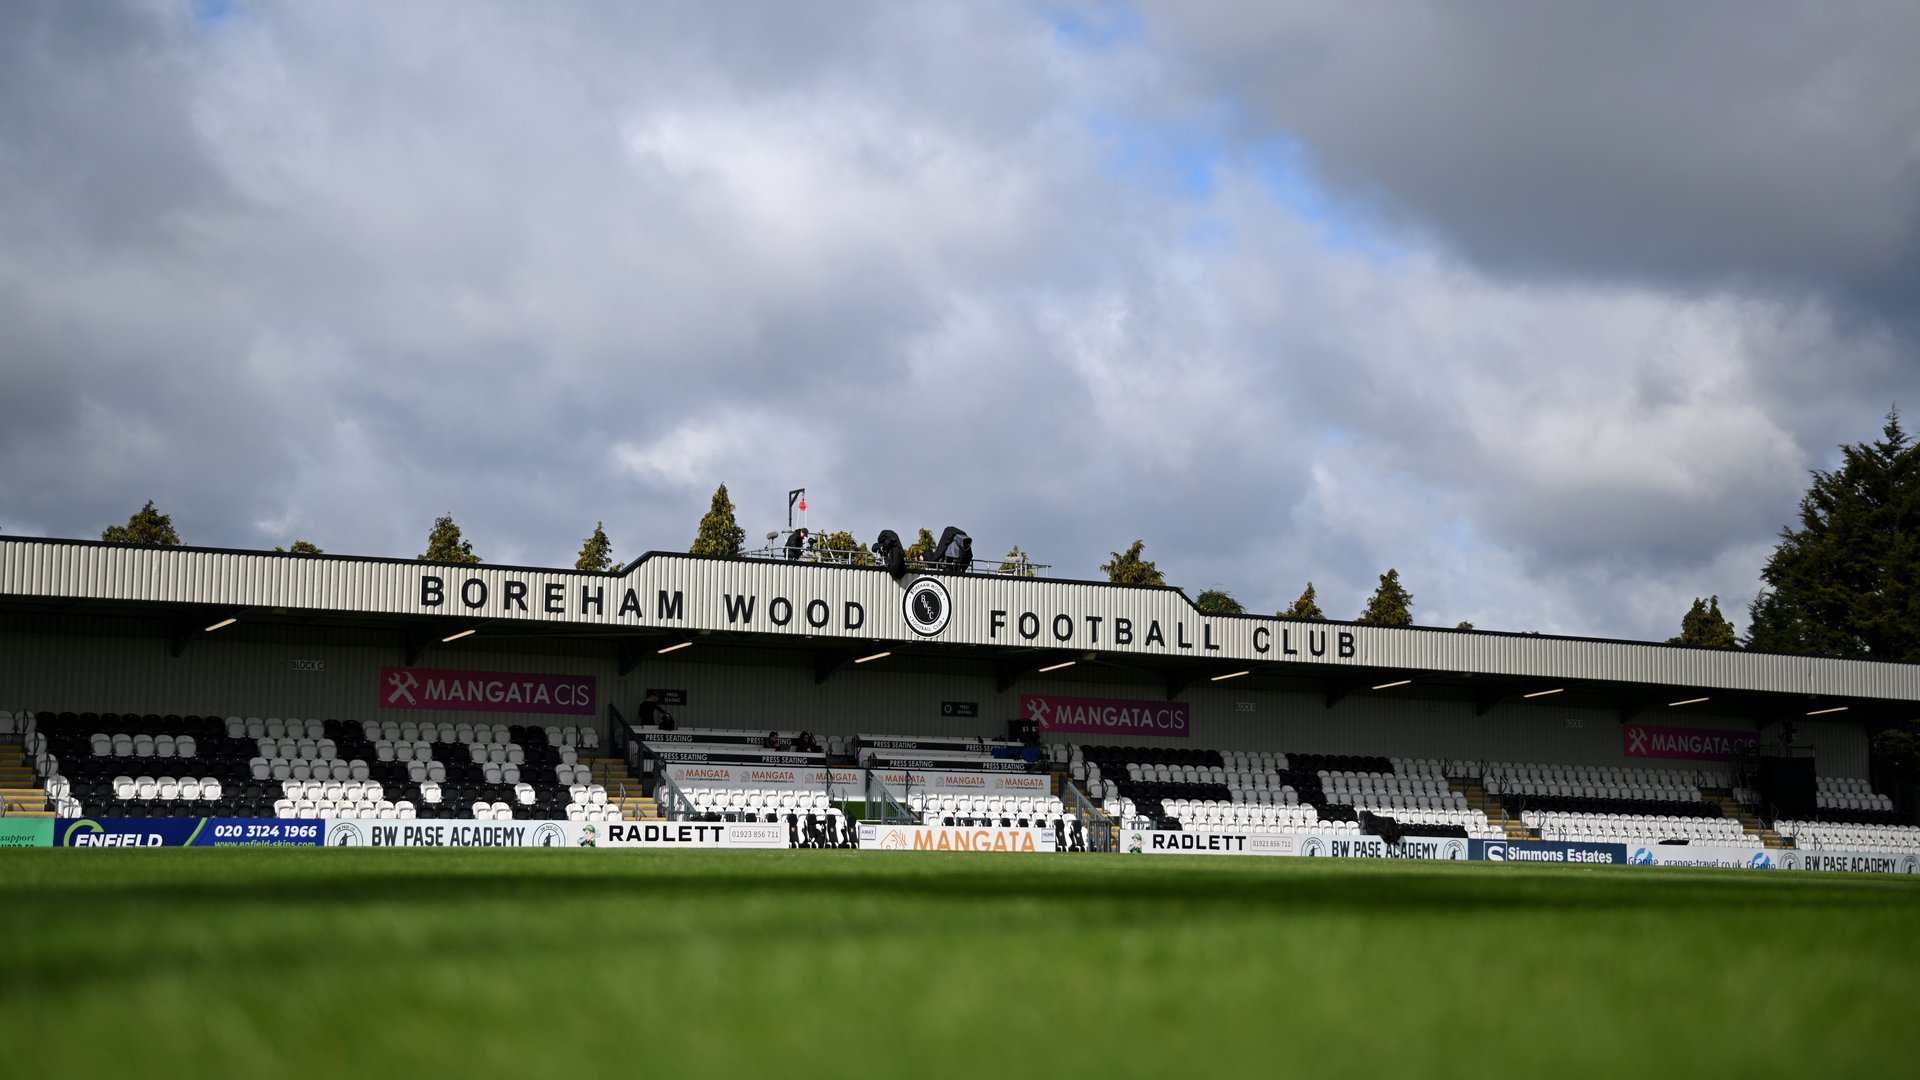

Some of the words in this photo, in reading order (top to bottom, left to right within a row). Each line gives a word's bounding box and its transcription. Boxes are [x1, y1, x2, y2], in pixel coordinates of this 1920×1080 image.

[421, 575, 684, 621] BOREHAM
[724, 594, 864, 630] WOOD
[990, 610, 1220, 651] FOOTBALL
[1252, 626, 1355, 659] CLUB
[424, 678, 550, 704] MANGATA
[554, 684, 590, 706] CIS
[1054, 704, 1154, 728] MANGATA
[1157, 709, 1185, 731] CIS
[645, 734, 664, 742] PRESS
[665, 735, 693, 743] SEATING
[746, 737, 764, 745] PRESS
[892, 741, 917, 749] SEATING
[1651, 733, 1731, 755] MANGATA
[680, 753, 708, 761] SEATING
[781, 756, 808, 764] SEATING
[908, 760, 934, 768] SEATING
[1000, 763, 1025, 771] SEATING
[686, 769, 730, 778] MANGATA
[752, 771, 795, 780] MANGATA
[815, 772, 858, 782] MANGATA
[884, 774, 926, 783] MANGATA
[945, 776, 986, 785] MANGATA
[1005, 778, 1044, 787] MANGATA
[214, 825, 243, 838] 020
[246, 825, 280, 838] 3124
[284, 826, 318, 839] 1966
[608, 825, 724, 842] RADLETT
[731, 830, 752, 839] 01923
[753, 830, 766, 839] 856
[767, 831, 779, 839] 711
[372, 826, 398, 847] BW
[404, 826, 444, 847] PASE
[451, 826, 525, 848] ACADEMY
[913, 829, 1036, 853] MANGATA
[1152, 833, 1247, 851] RADLETT
[1252, 840, 1269, 848] 01923
[1269, 840, 1280, 848] 856
[1332, 841, 1350, 858] BW
[1354, 841, 1382, 859] PASE
[1385, 842, 1438, 860] ACADEMY
[1508, 846, 1564, 861] Simmons
[1567, 848, 1613, 864] Estates
[1805, 855, 1821, 871] BW
[1823, 856, 1848, 872] PASE
[1851, 857, 1897, 874] ACADEMY
